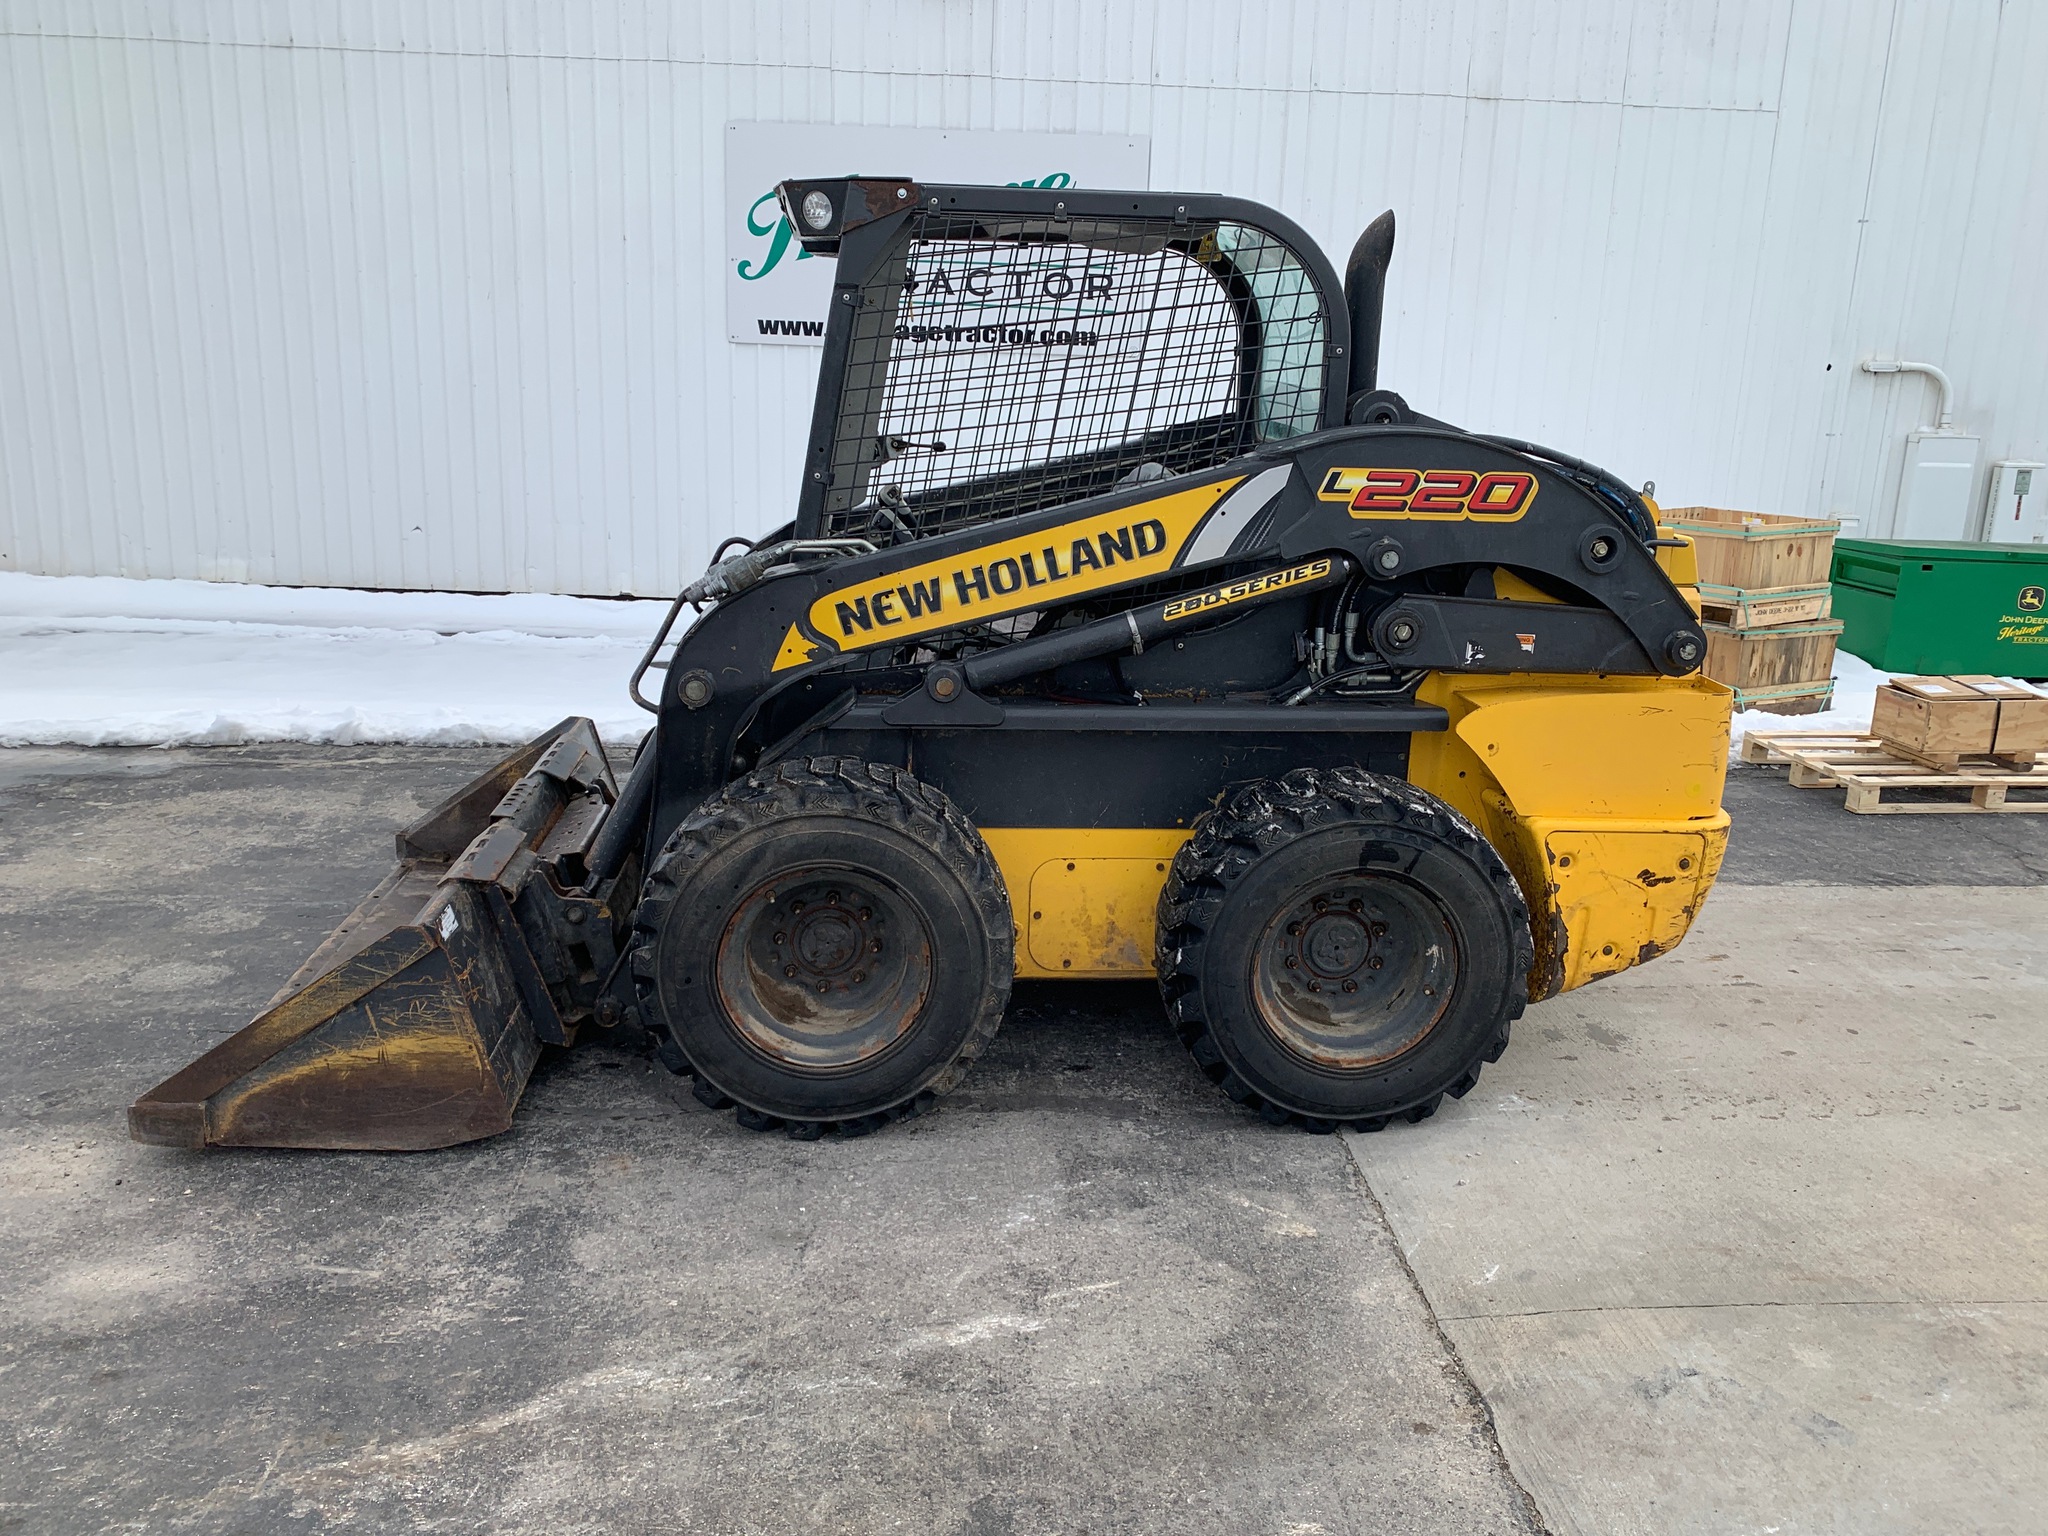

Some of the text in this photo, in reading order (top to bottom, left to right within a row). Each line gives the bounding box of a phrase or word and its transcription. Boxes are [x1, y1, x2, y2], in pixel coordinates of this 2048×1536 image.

[834, 517, 1167, 637] NEW HOLLAND
[1230, 560, 1329, 599] SERIES
[1999, 614, 2048, 625] JOHN DEER
